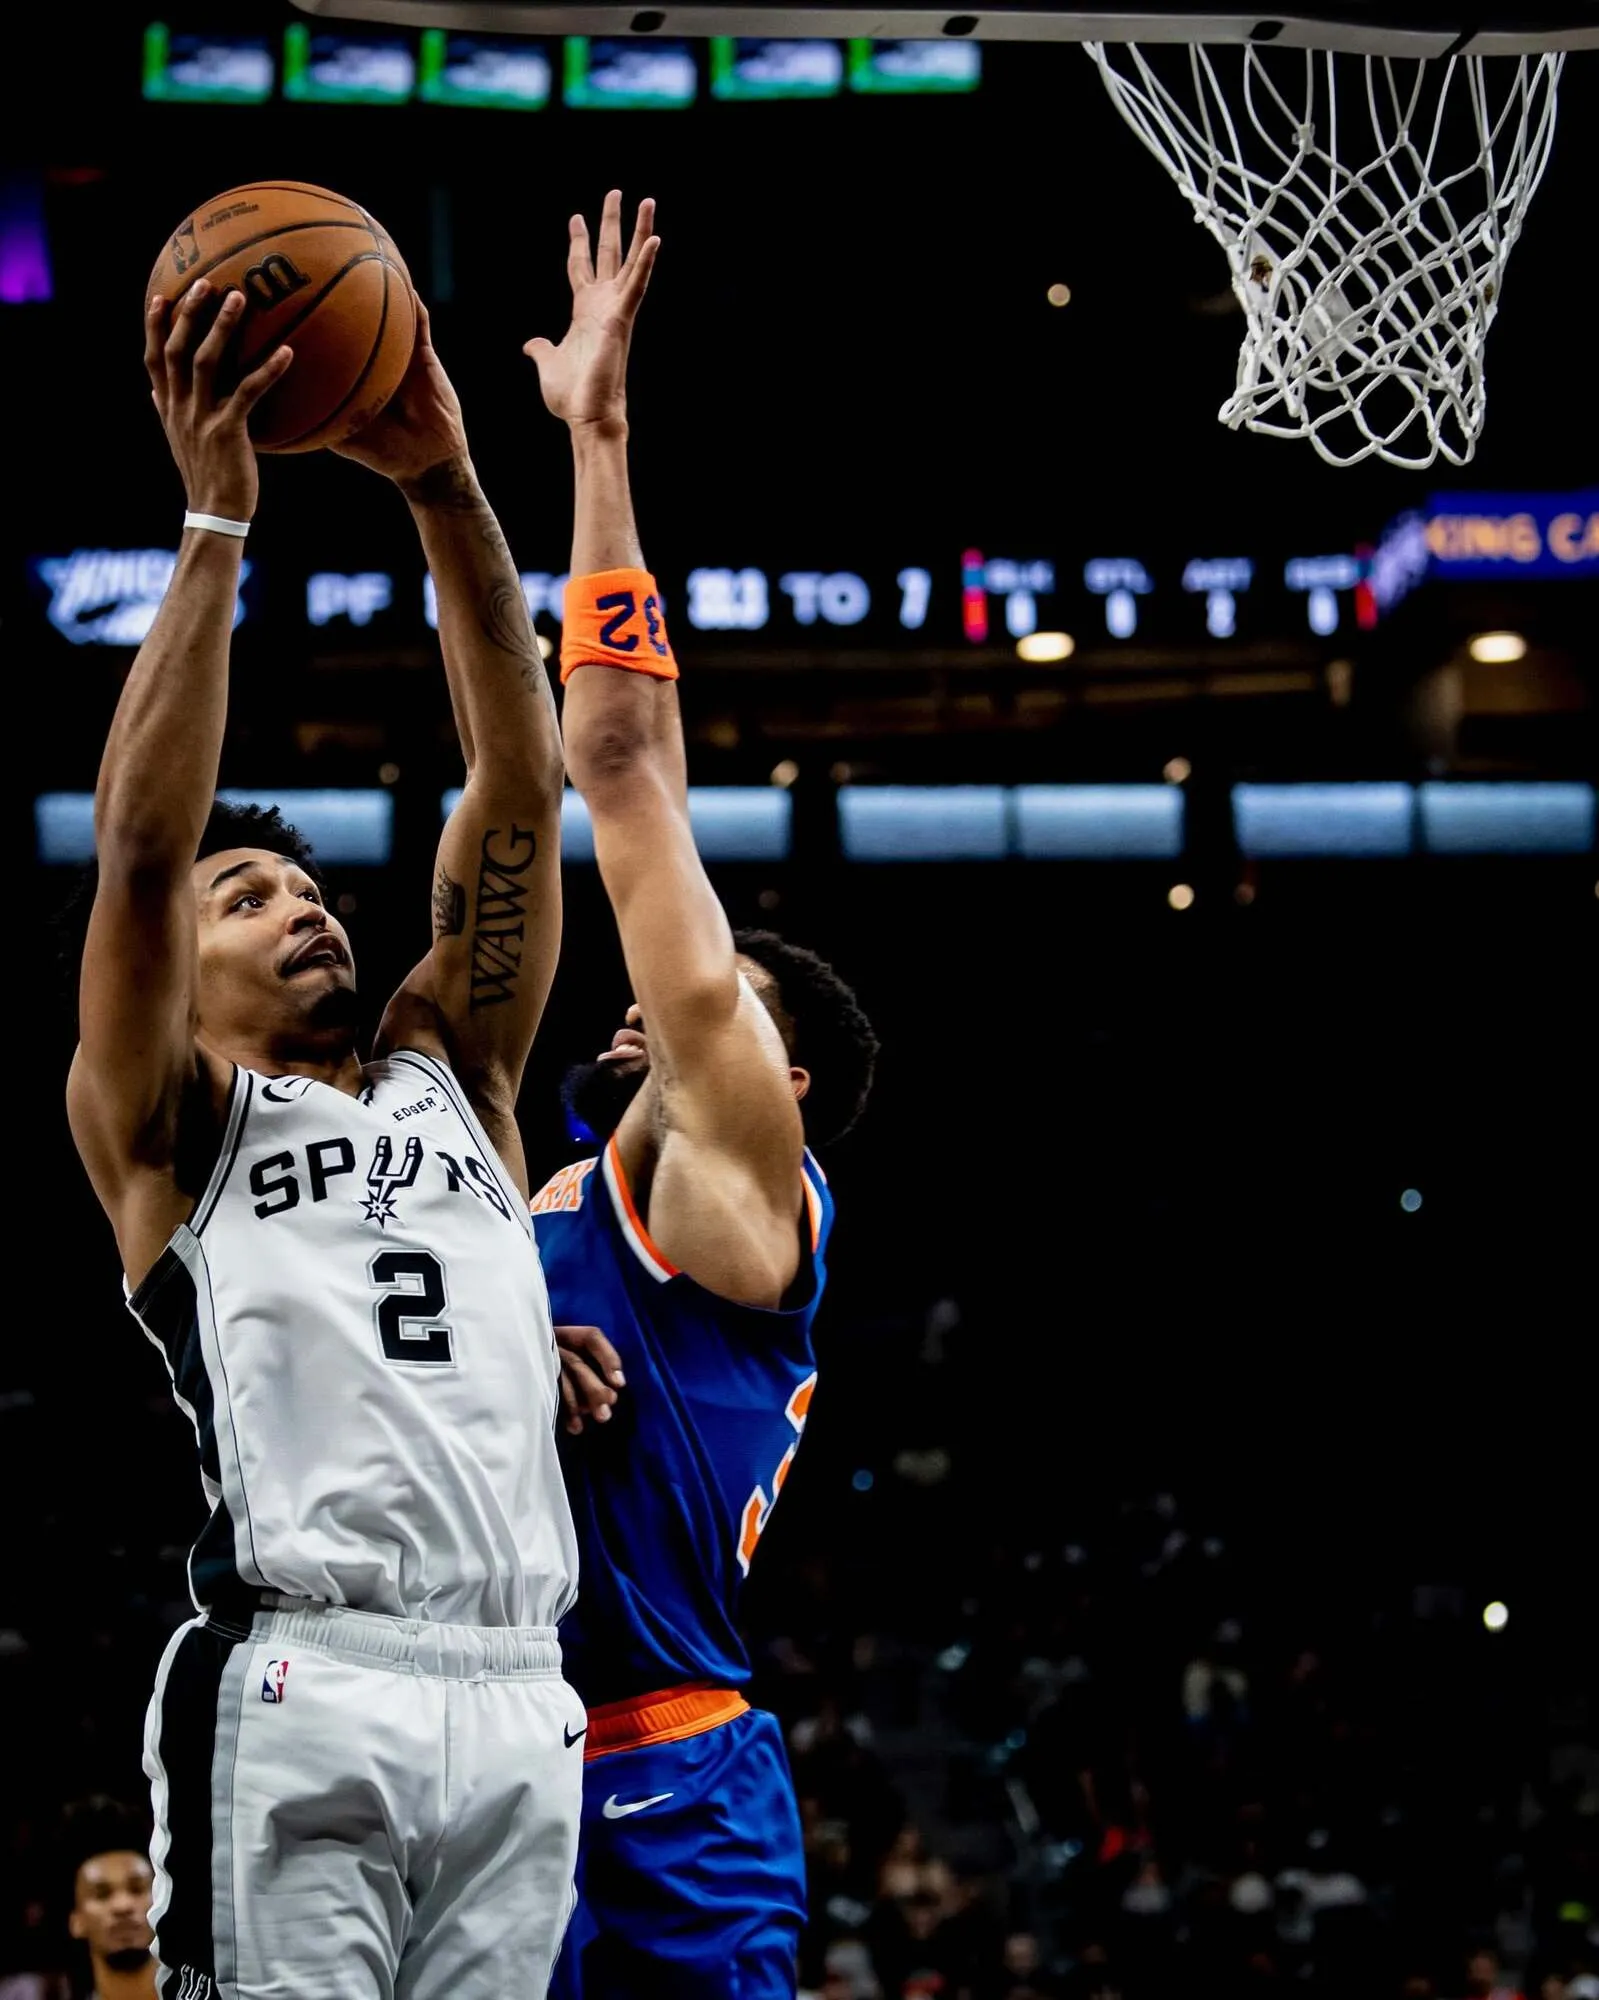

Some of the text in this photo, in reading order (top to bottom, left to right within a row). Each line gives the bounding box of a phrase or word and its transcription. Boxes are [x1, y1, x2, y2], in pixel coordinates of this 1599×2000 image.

[780, 572, 869, 625] TO
[470, 823, 537, 1014] WAWG
[249, 1136, 511, 1224] SPURS
[366, 1248, 456, 1368] 2
